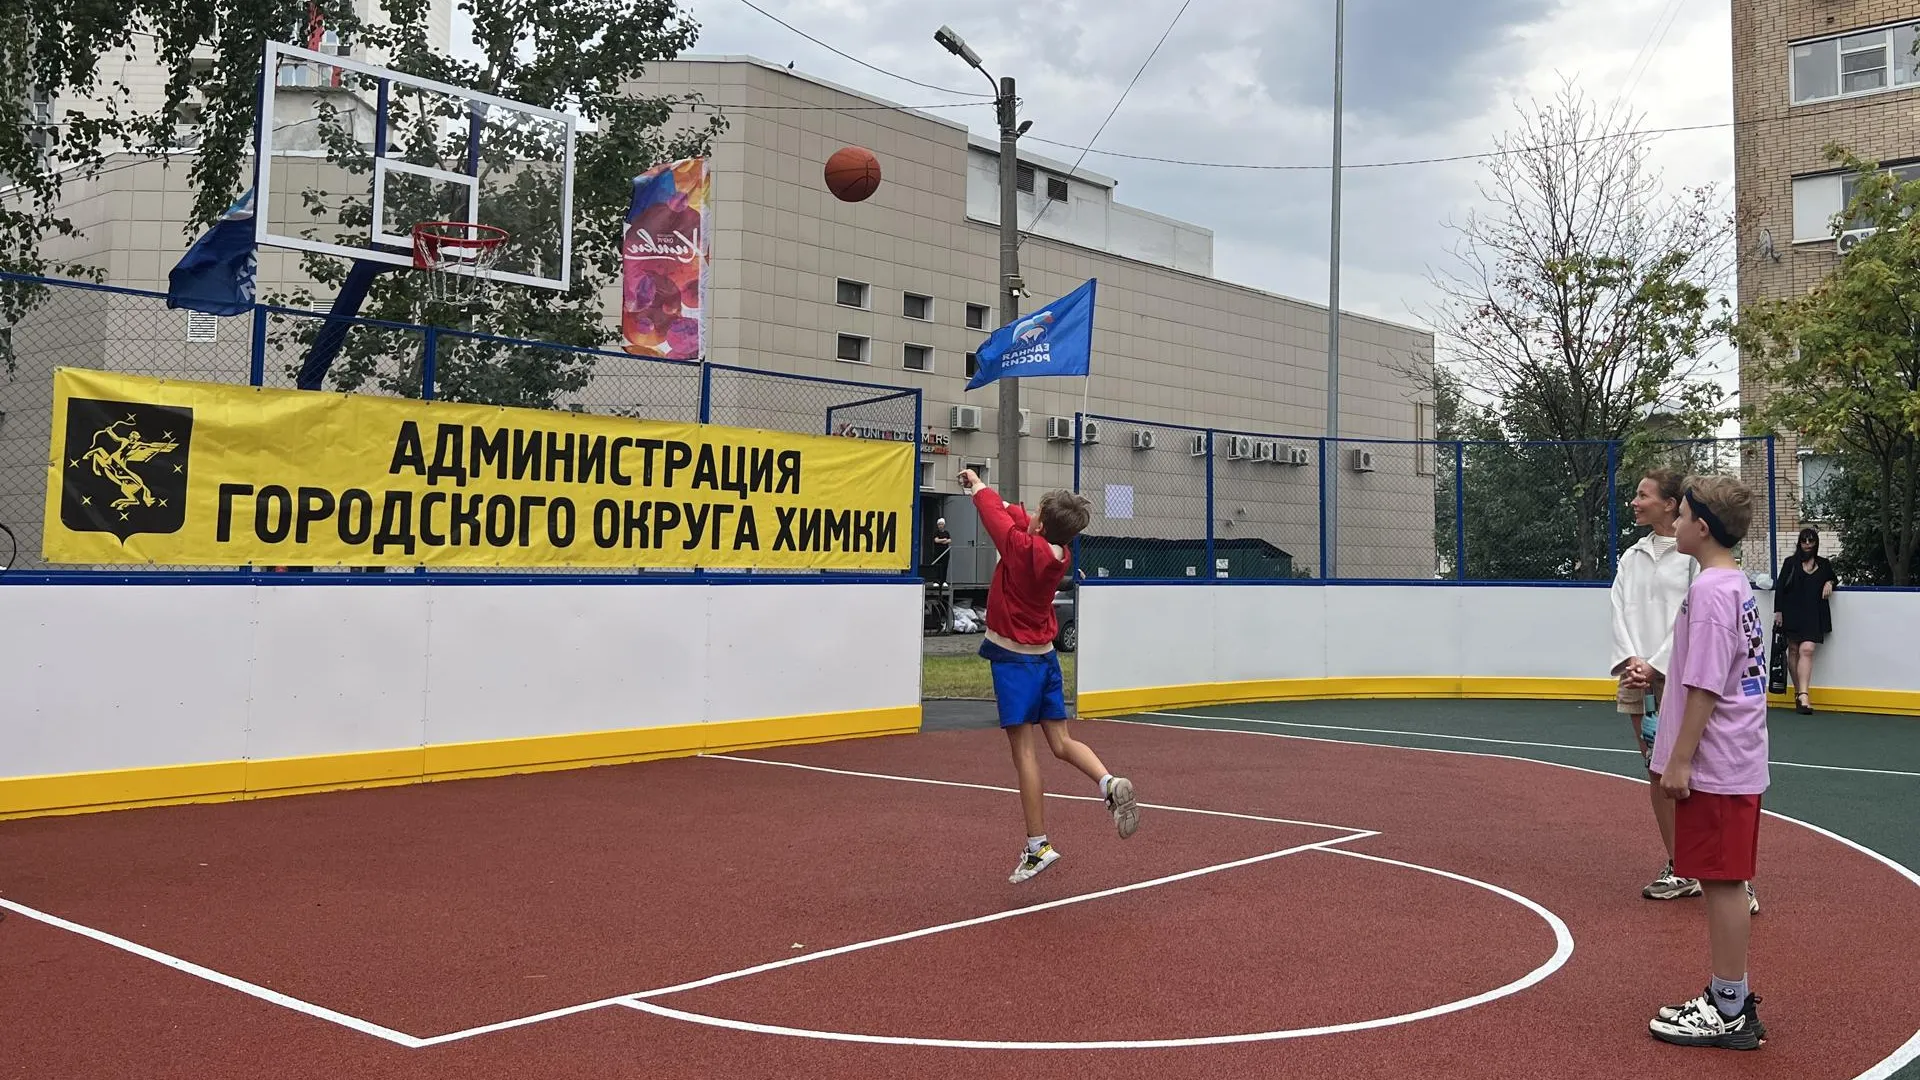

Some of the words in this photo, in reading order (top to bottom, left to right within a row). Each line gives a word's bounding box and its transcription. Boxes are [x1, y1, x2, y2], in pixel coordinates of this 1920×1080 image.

[389, 420, 801, 500] АДМИНИСТРАЦИЯ
[907, 432, 950, 445] GMERS
[216, 483, 576, 556] ГОРОДСКОГО
[593, 498, 760, 552] ОКРУГА
[772, 506, 897, 553] ХИМКИ
